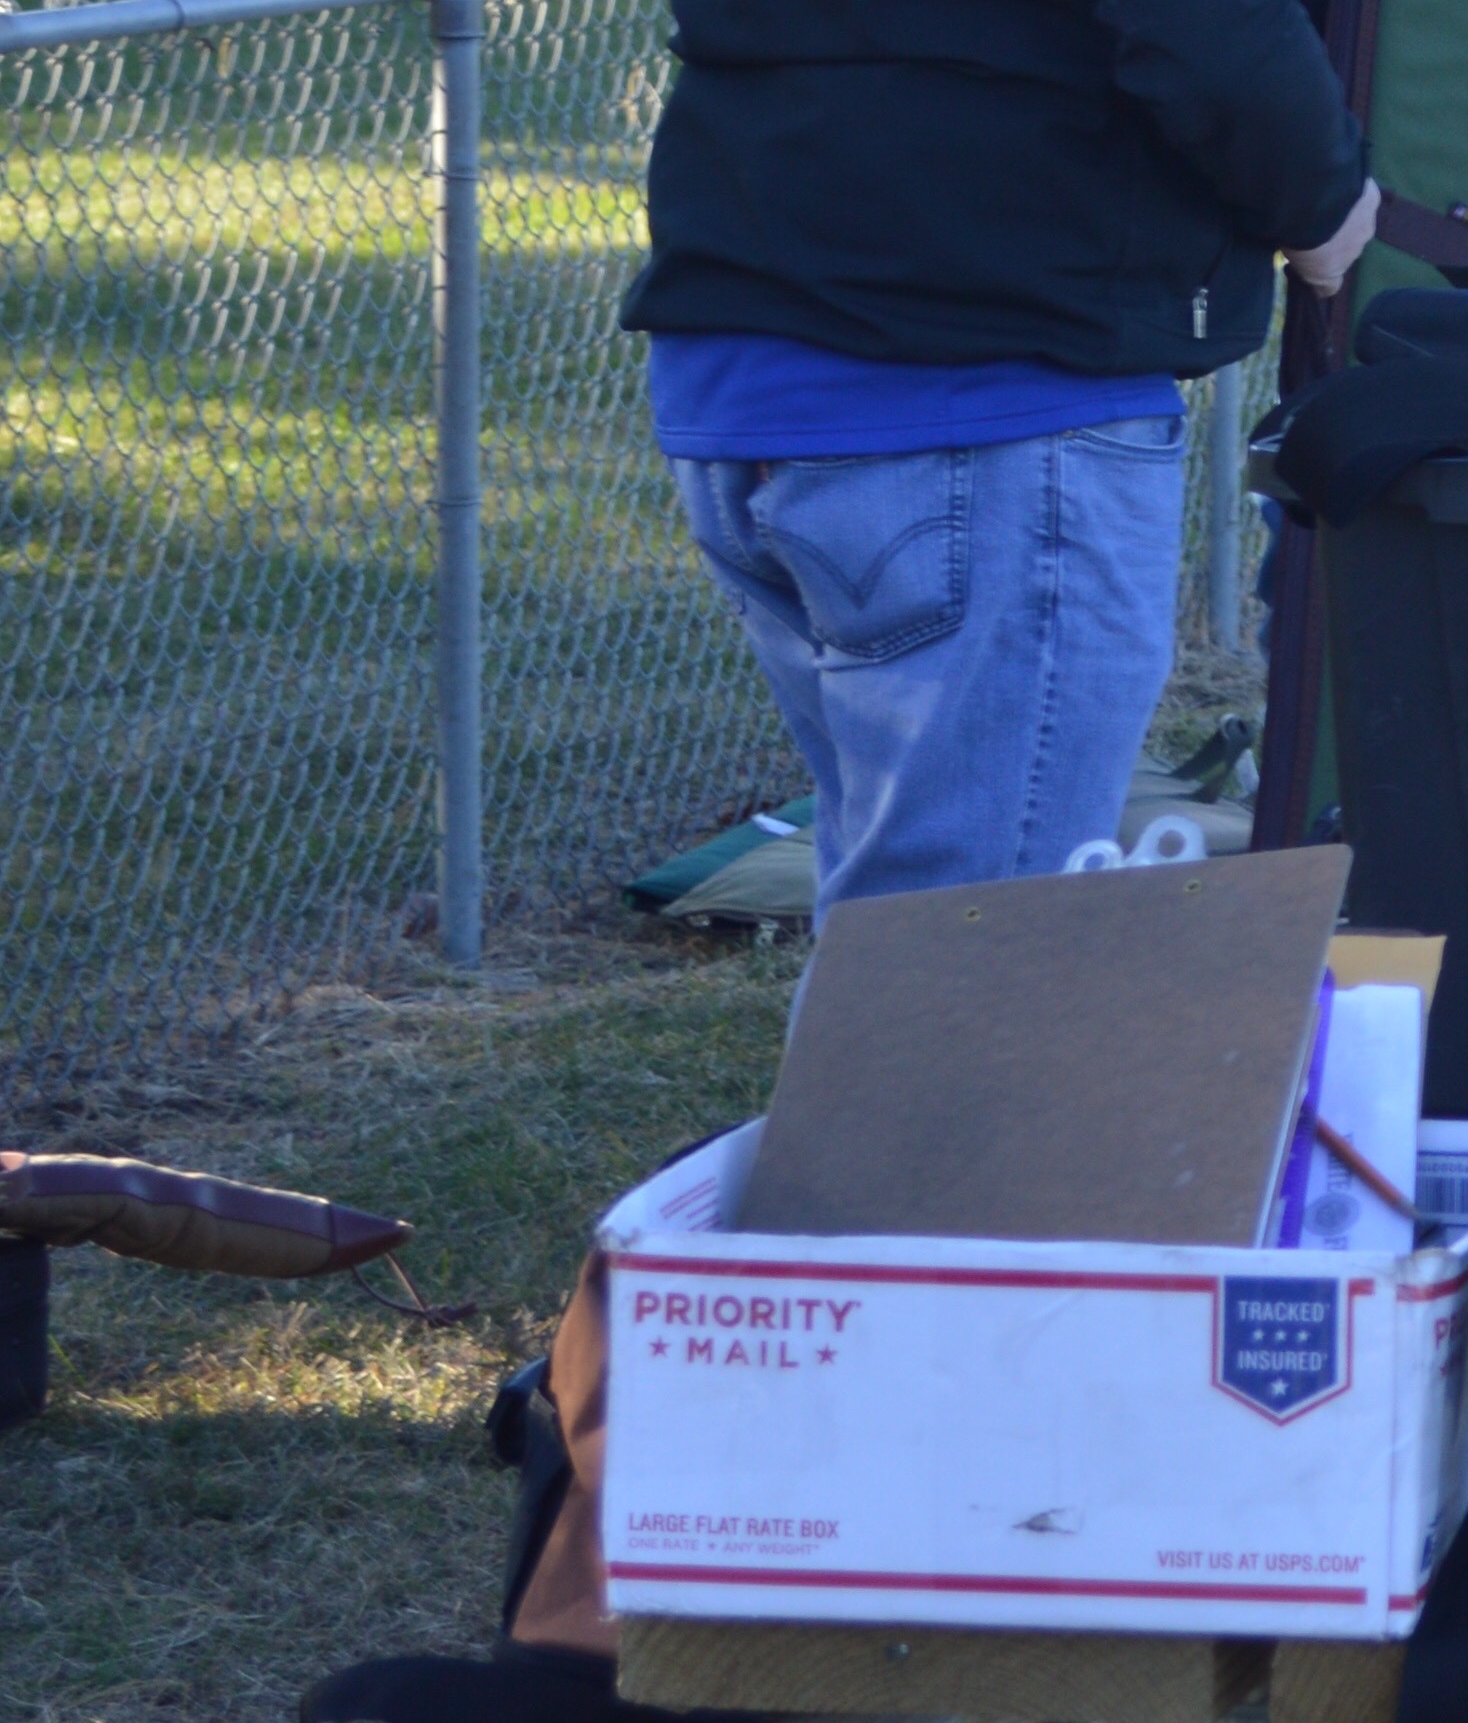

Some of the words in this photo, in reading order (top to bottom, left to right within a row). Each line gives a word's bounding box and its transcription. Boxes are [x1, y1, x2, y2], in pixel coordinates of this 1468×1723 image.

[634, 1290, 854, 1333] PRIORITY
[1238, 1300, 1326, 1323] TRACKED
[686, 1336, 799, 1369] MAIL
[1237, 1349, 1323, 1372] INSURED
[627, 1512, 690, 1533] LARGE
[695, 1515, 741, 1536] FLAT
[746, 1517, 795, 1538] RATE
[800, 1519, 840, 1539] BOX
[628, 1537, 658, 1550] ONE
[662, 1538, 698, 1552] RATE
[723, 1541, 752, 1554] ANY
[1156, 1550, 1204, 1569] VISIT
[1208, 1552, 1233, 1570] US
[1238, 1553, 1260, 1570] AT
